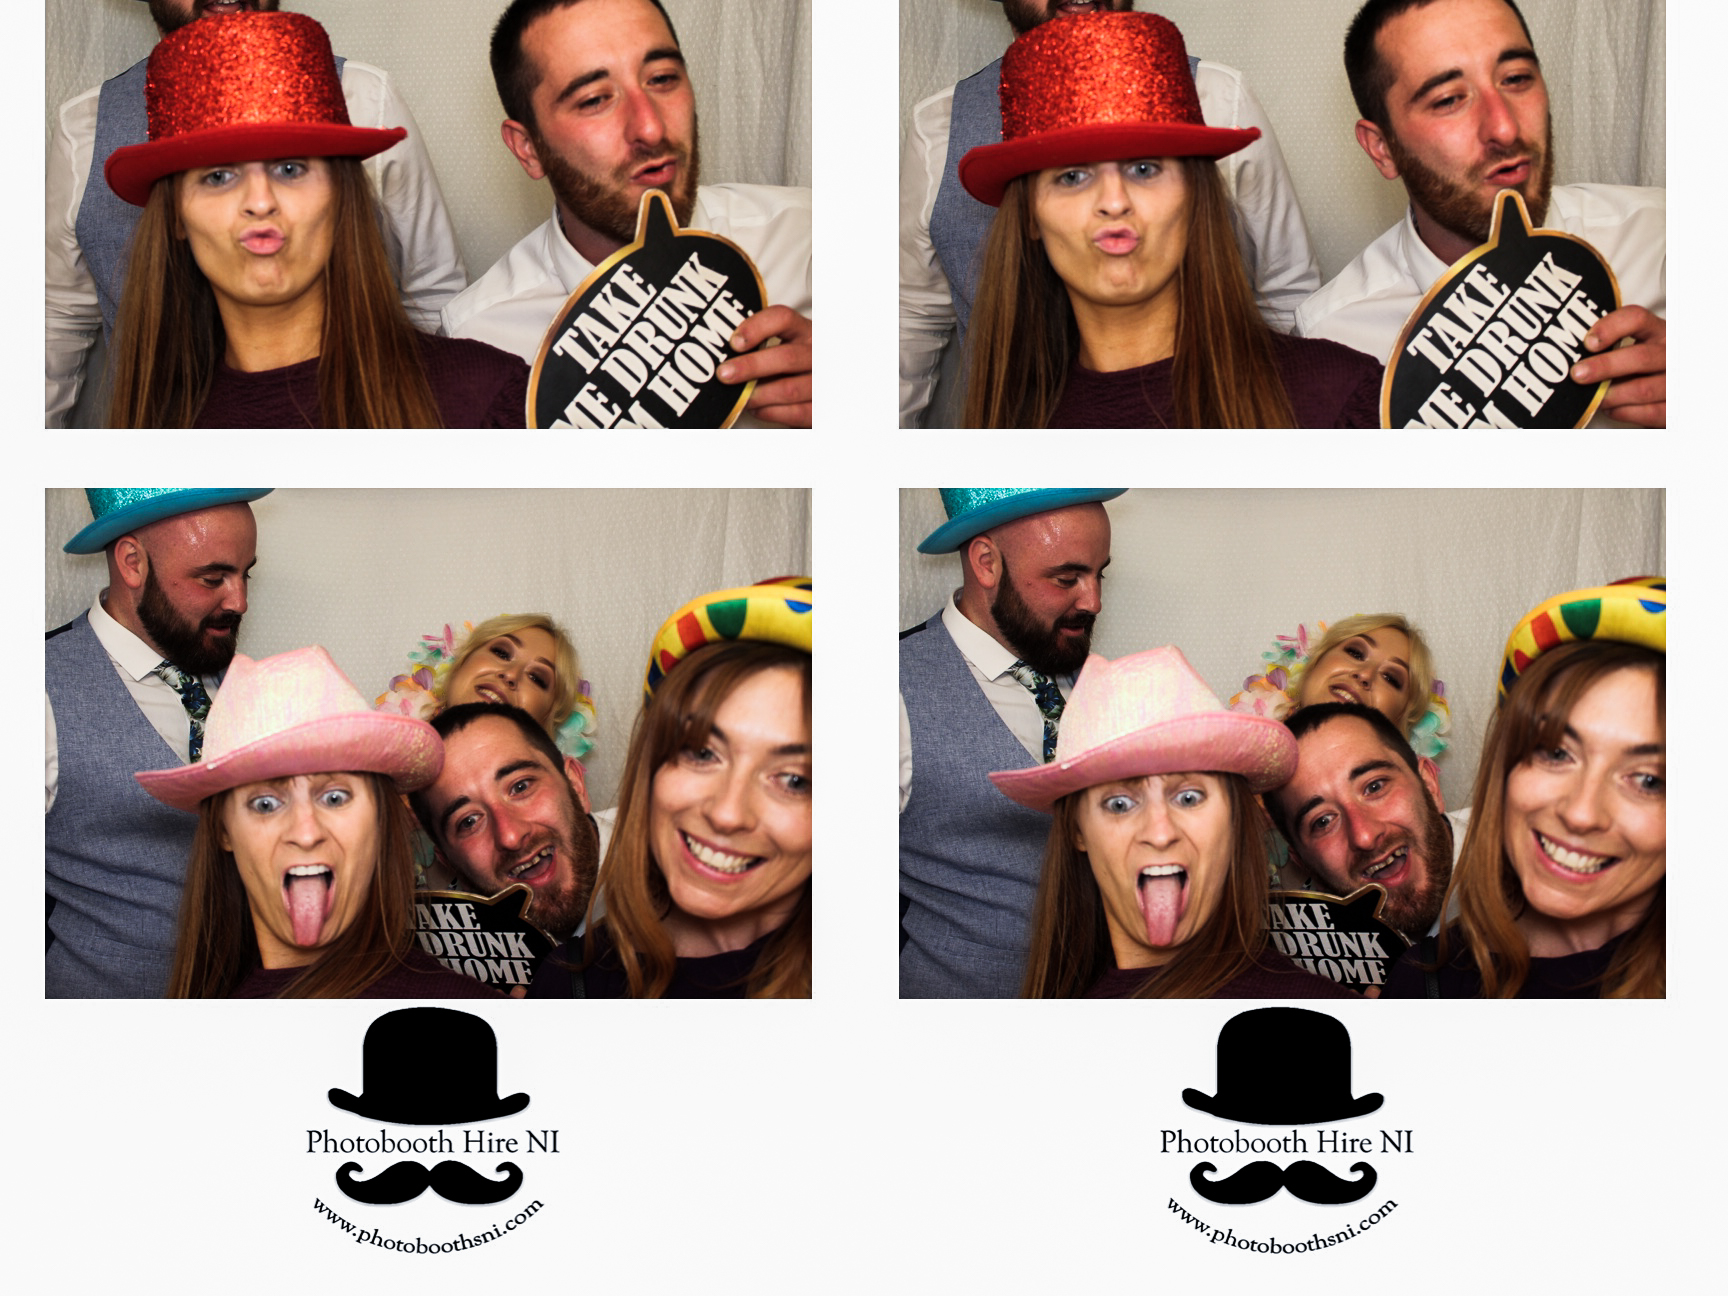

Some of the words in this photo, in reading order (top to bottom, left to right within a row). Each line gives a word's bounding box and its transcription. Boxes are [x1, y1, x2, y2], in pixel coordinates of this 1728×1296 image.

[552, 263, 657, 375] TAKE
[600, 251, 729, 398] DRUNK
[647, 289, 754, 417] HOME
[1406, 263, 1511, 375] TAKE
[1454, 251, 1583, 398] DRUNK
[1501, 289, 1608, 417] HOME
[406, 903, 481, 930] AKE
[416, 931, 535, 959] DRUNK
[1260, 903, 1335, 930] AKE
[1270, 931, 1389, 959] DRUNK
